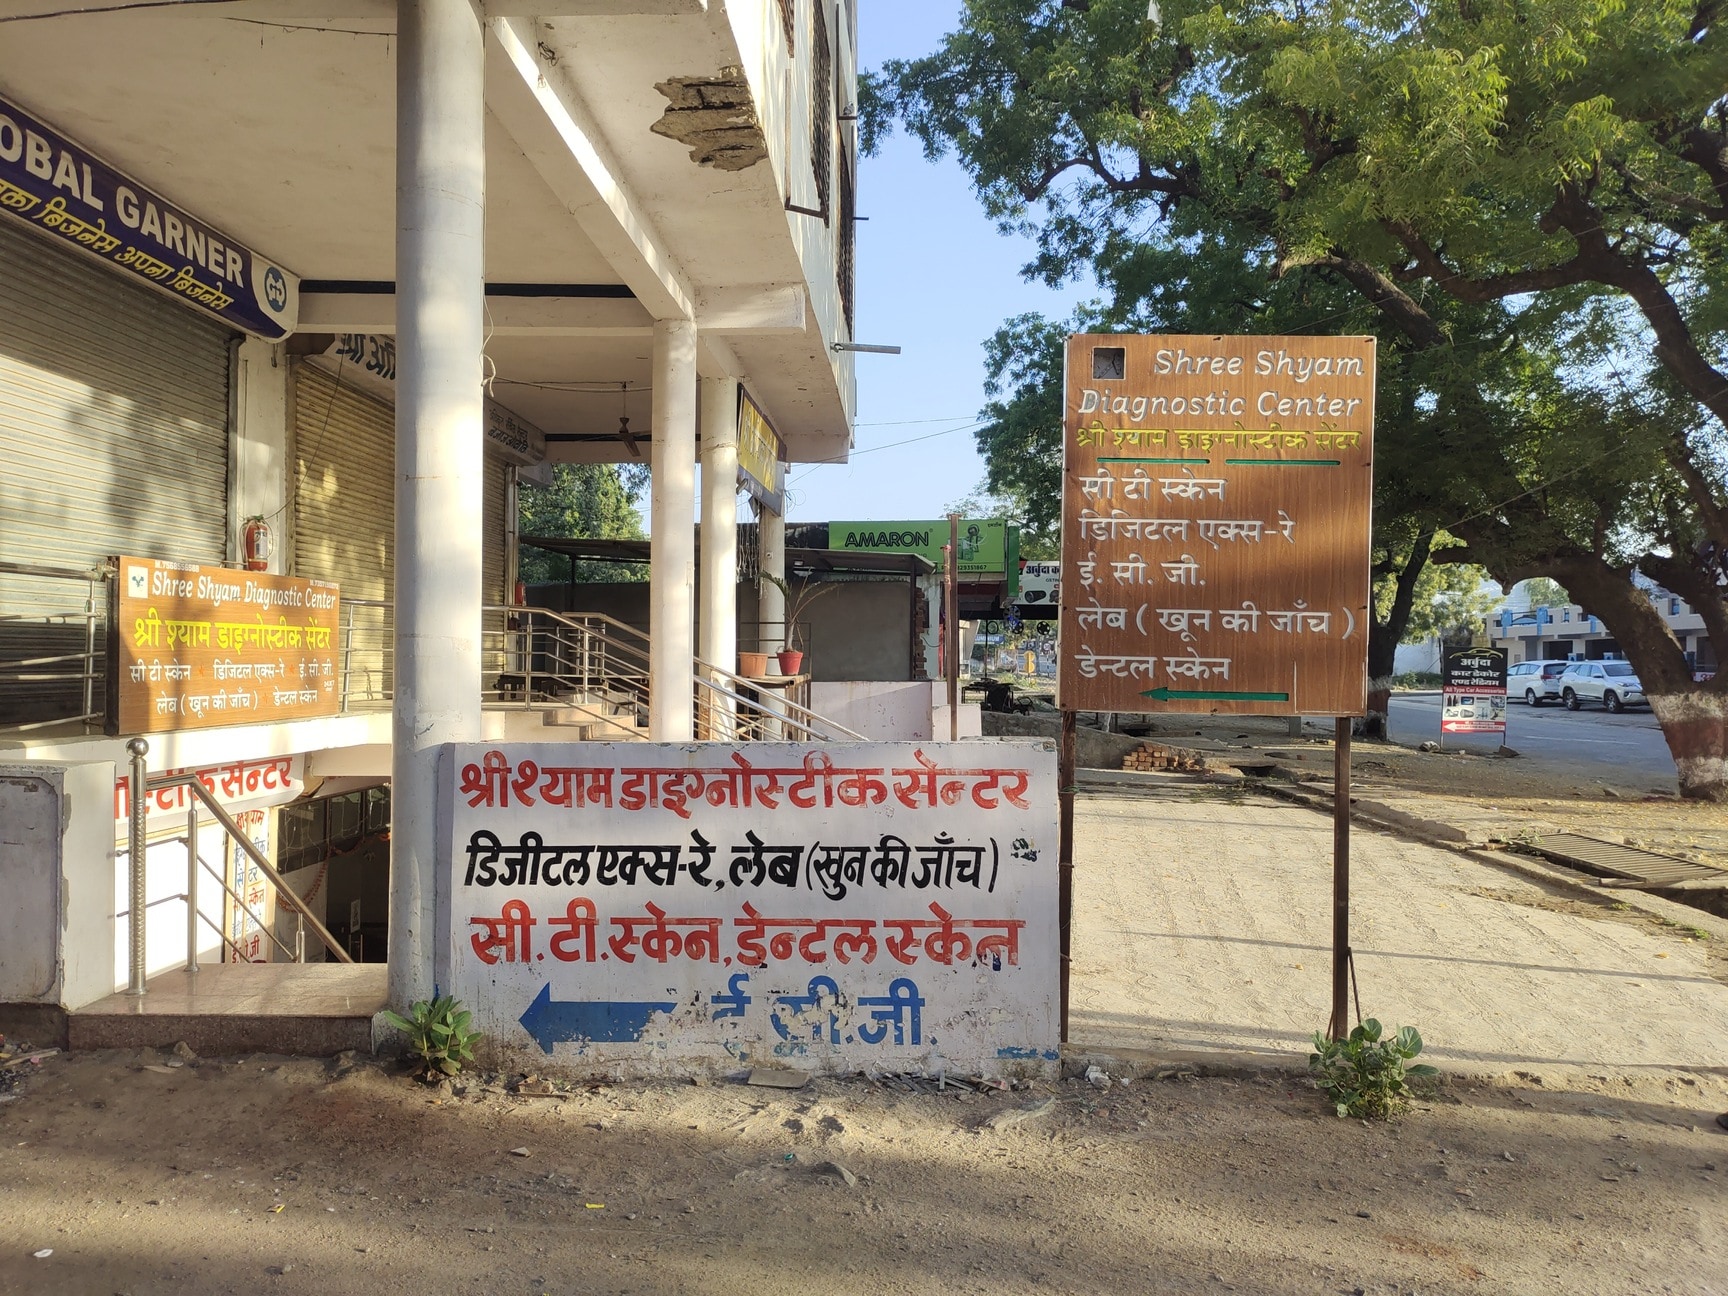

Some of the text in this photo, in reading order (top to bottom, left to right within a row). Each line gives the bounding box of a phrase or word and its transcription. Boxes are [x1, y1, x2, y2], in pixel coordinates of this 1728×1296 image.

[116, 186, 244, 288] GARNER
[114, 246, 175, 280] अपना
[1154, 349, 1365, 384] Shree Shyam
[1078, 389, 1362, 422] Diagnostic Center
[1075, 420, 1107, 450] श्री
[1111, 427, 1170, 452] श्याम
[1313, 421, 1363, 451] सेंटर
[1078, 467, 1228, 502] सी टी स्केन
[844, 531, 929, 548] AMARON
[1077, 508, 1191, 542] डिजिटल
[152, 571, 336, 610] Shree Shyam Diagnostic Center
[133, 607, 162, 648] श्री
[165, 619, 211, 651] श्याम
[304, 616, 331, 650] सेंटर
[1074, 596, 1129, 631] लेब
[1218, 601, 1262, 634] की
[129, 658, 146, 683] सी
[148, 658, 162, 682] टी
[164, 658, 191, 681] स्केन
[213, 658, 252, 681] डिजिटल
[1073, 644, 1233, 682] डेन्टल स्केन
[156, 691, 177, 716] लेब
[212, 690, 226, 711] की
[299, 686, 318, 703] स्केन
[459, 750, 512, 808] श्री
[511, 760, 615, 809] श्याम
[891, 748, 1034, 810] सेन्टर
[464, 829, 596, 887] डिजीटल
[729, 829, 804, 888] लेब
